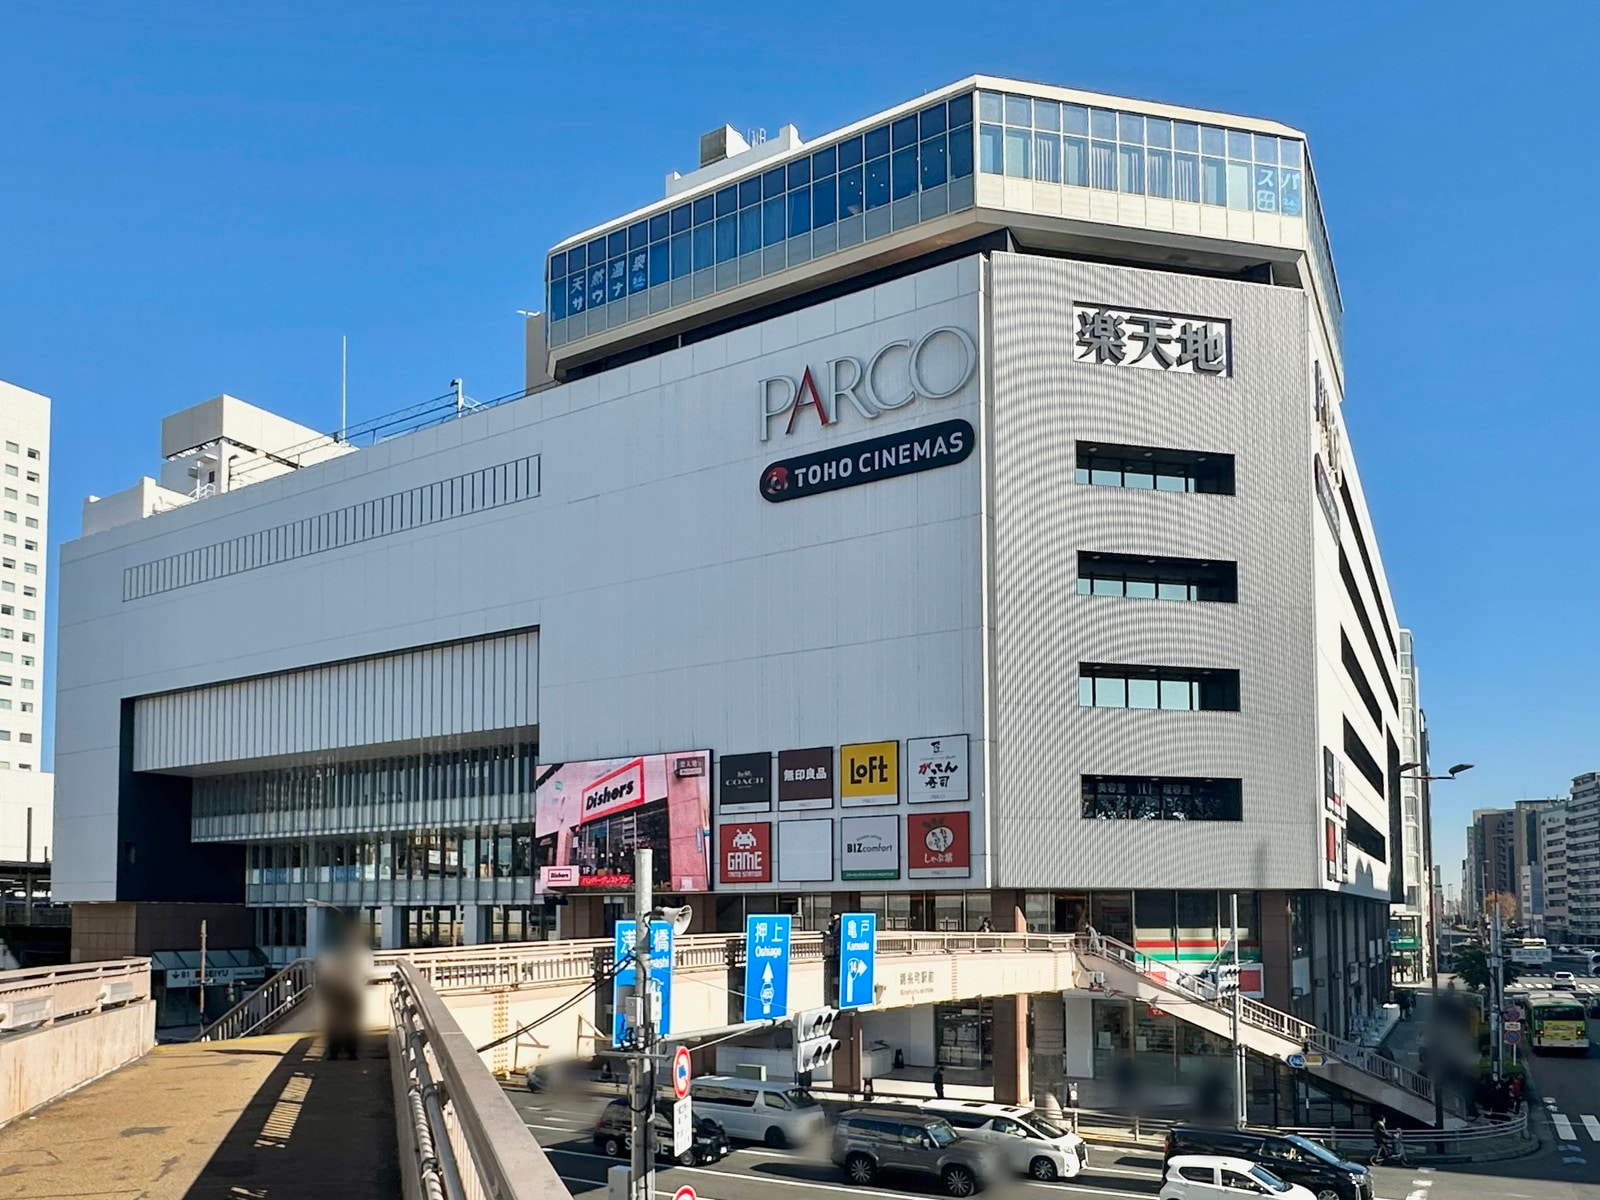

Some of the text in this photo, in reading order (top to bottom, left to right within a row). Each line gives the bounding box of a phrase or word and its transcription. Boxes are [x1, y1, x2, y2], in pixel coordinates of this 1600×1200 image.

[1257, 168, 1300, 190] スパ
[572, 282, 624, 311] サウナ
[1075, 307, 1226, 375] 楽天地
[758, 325, 977, 442] PARCO
[794, 431, 964, 488] TOHO CINEMAS
[725, 777, 764, 786] COACH
[783, 767, 827, 781] 無印良品
[585, 780, 634, 811] Dishers
[727, 851, 763, 871] GAME
[755, 922, 783, 943] 押上
[847, 919, 870, 938] 亀戸
[620, 928, 669, 953] 浅橋
